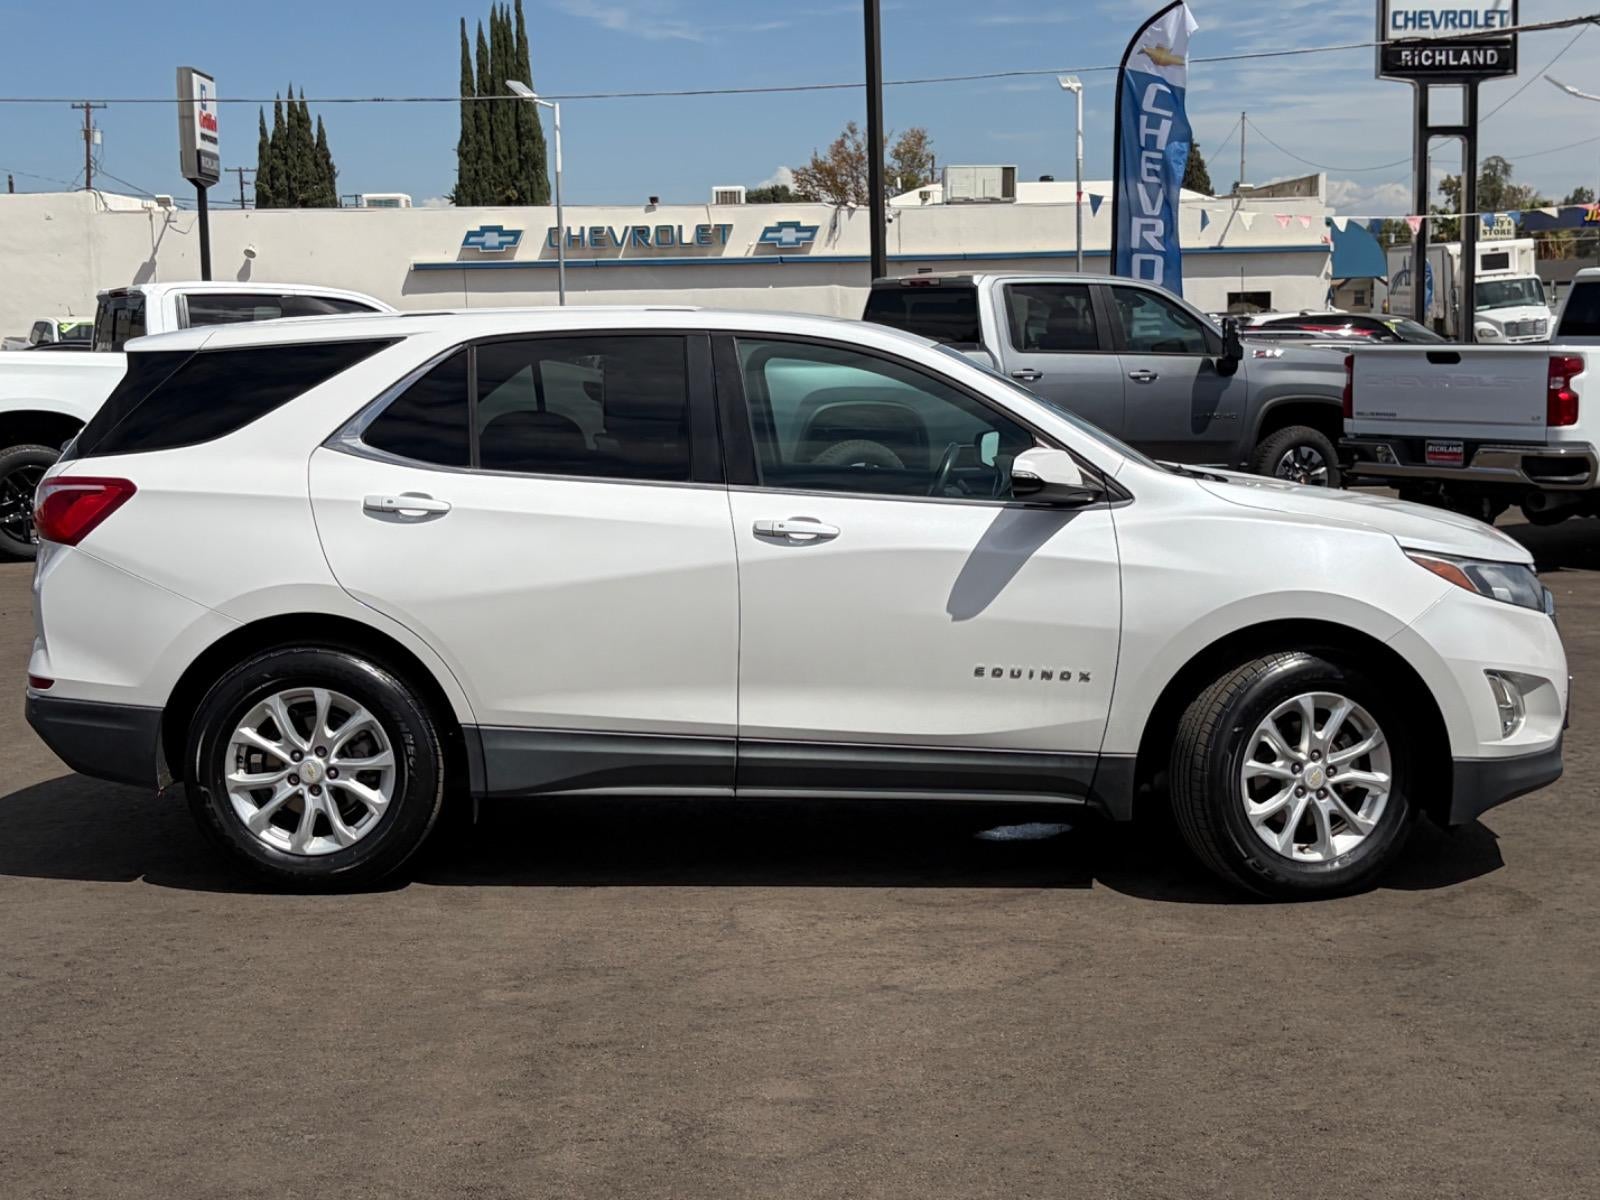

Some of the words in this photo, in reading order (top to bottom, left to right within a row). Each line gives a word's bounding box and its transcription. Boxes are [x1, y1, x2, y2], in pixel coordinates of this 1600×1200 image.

[1392, 9, 1510, 30] CHEVROLET
[1400, 49, 1499, 66] RICHLAND
[547, 224, 734, 248] CHEVROLET
[974, 666, 1092, 683] EQUINOX
